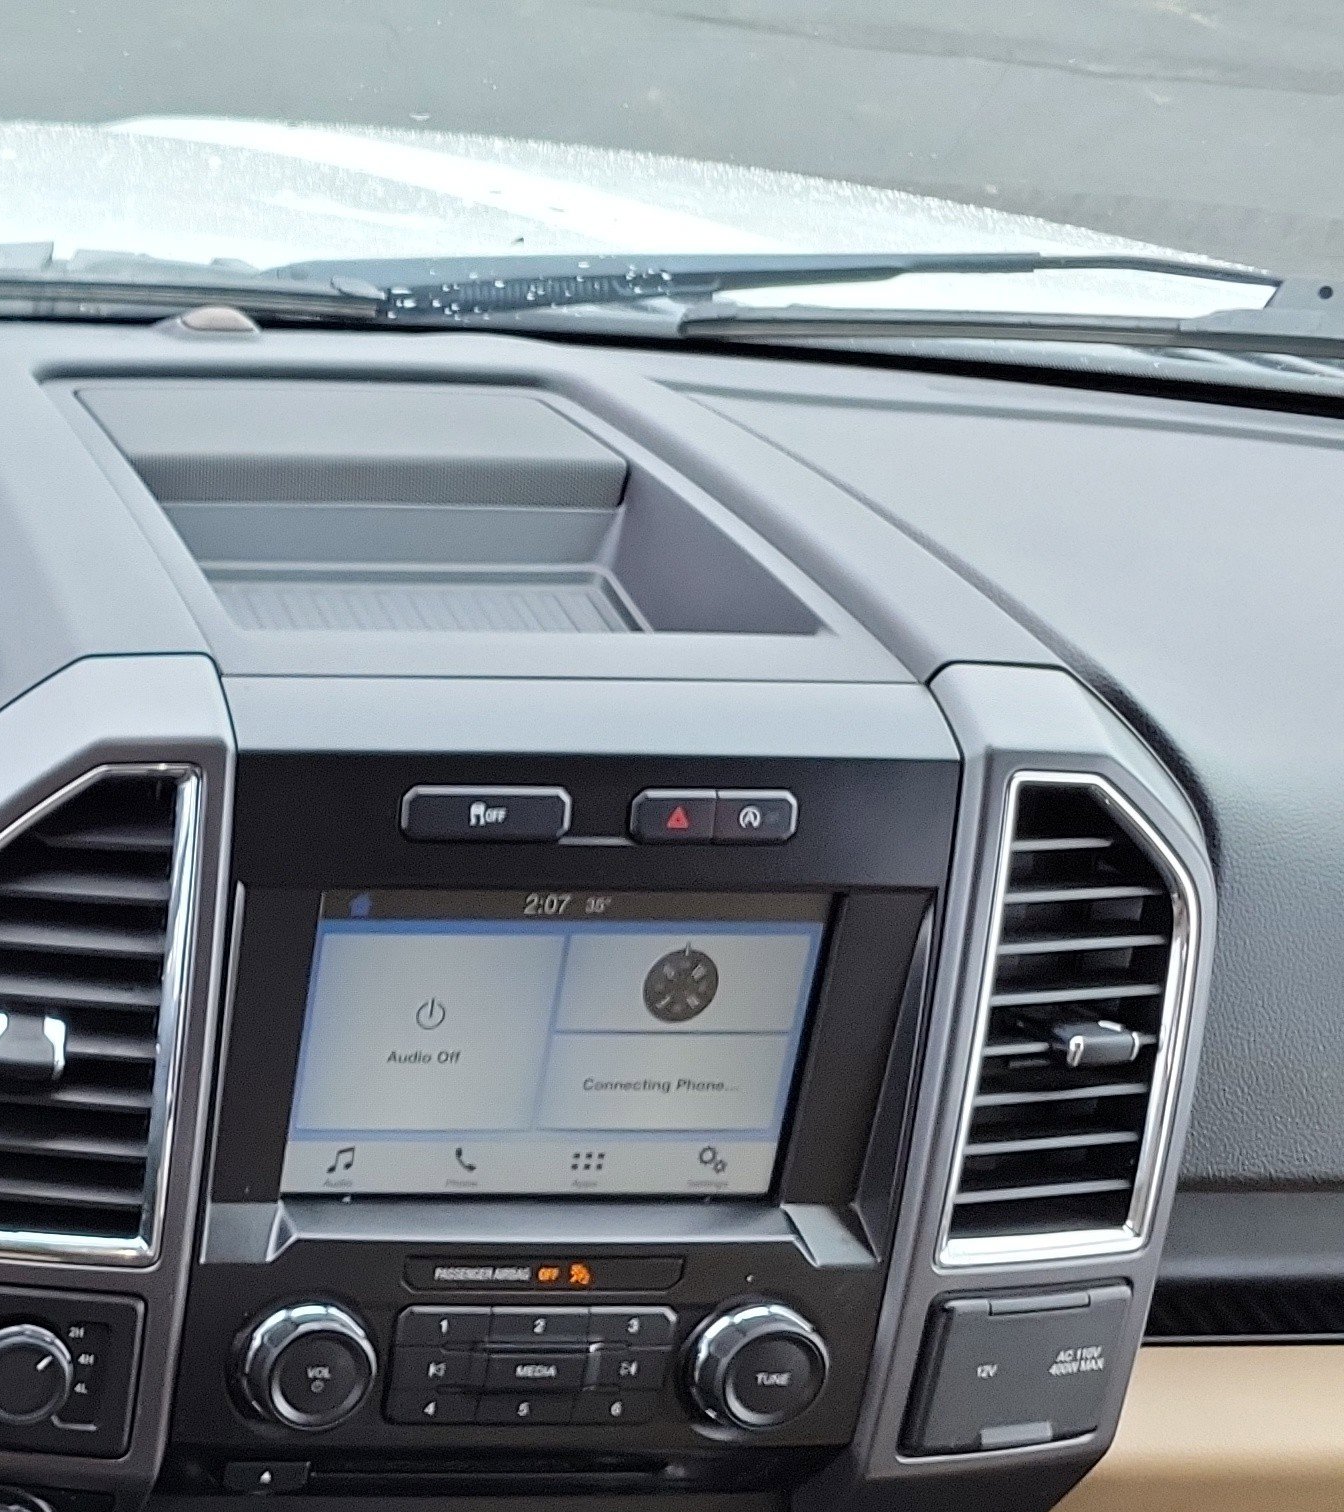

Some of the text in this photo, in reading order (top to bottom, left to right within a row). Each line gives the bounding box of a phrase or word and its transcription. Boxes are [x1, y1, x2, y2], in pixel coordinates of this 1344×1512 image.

[485, 808, 507, 823] OFF
[523, 892, 572, 915] 2:07
[386, 1050, 461, 1064] Audio Off
[583, 1077, 671, 1094] Connecting
[68, 1326, 84, 1339] 2H
[439, 1318, 448, 1333] 1
[533, 1318, 547, 1334] 2
[627, 1318, 641, 1334] 3
[78, 1352, 95, 1365] 4H
[1079, 1357, 1105, 1371] MAX
[307, 1366, 331, 1379] VOL
[515, 1364, 557, 1377] MEDIA
[976, 1364, 999, 1378] 12V
[756, 1371, 792, 1387] TUNE
[74, 1381, 88, 1394] 4L
[423, 1401, 437, 1416] 4
[517, 1402, 530, 1417] 5
[610, 1402, 623, 1417] 6
